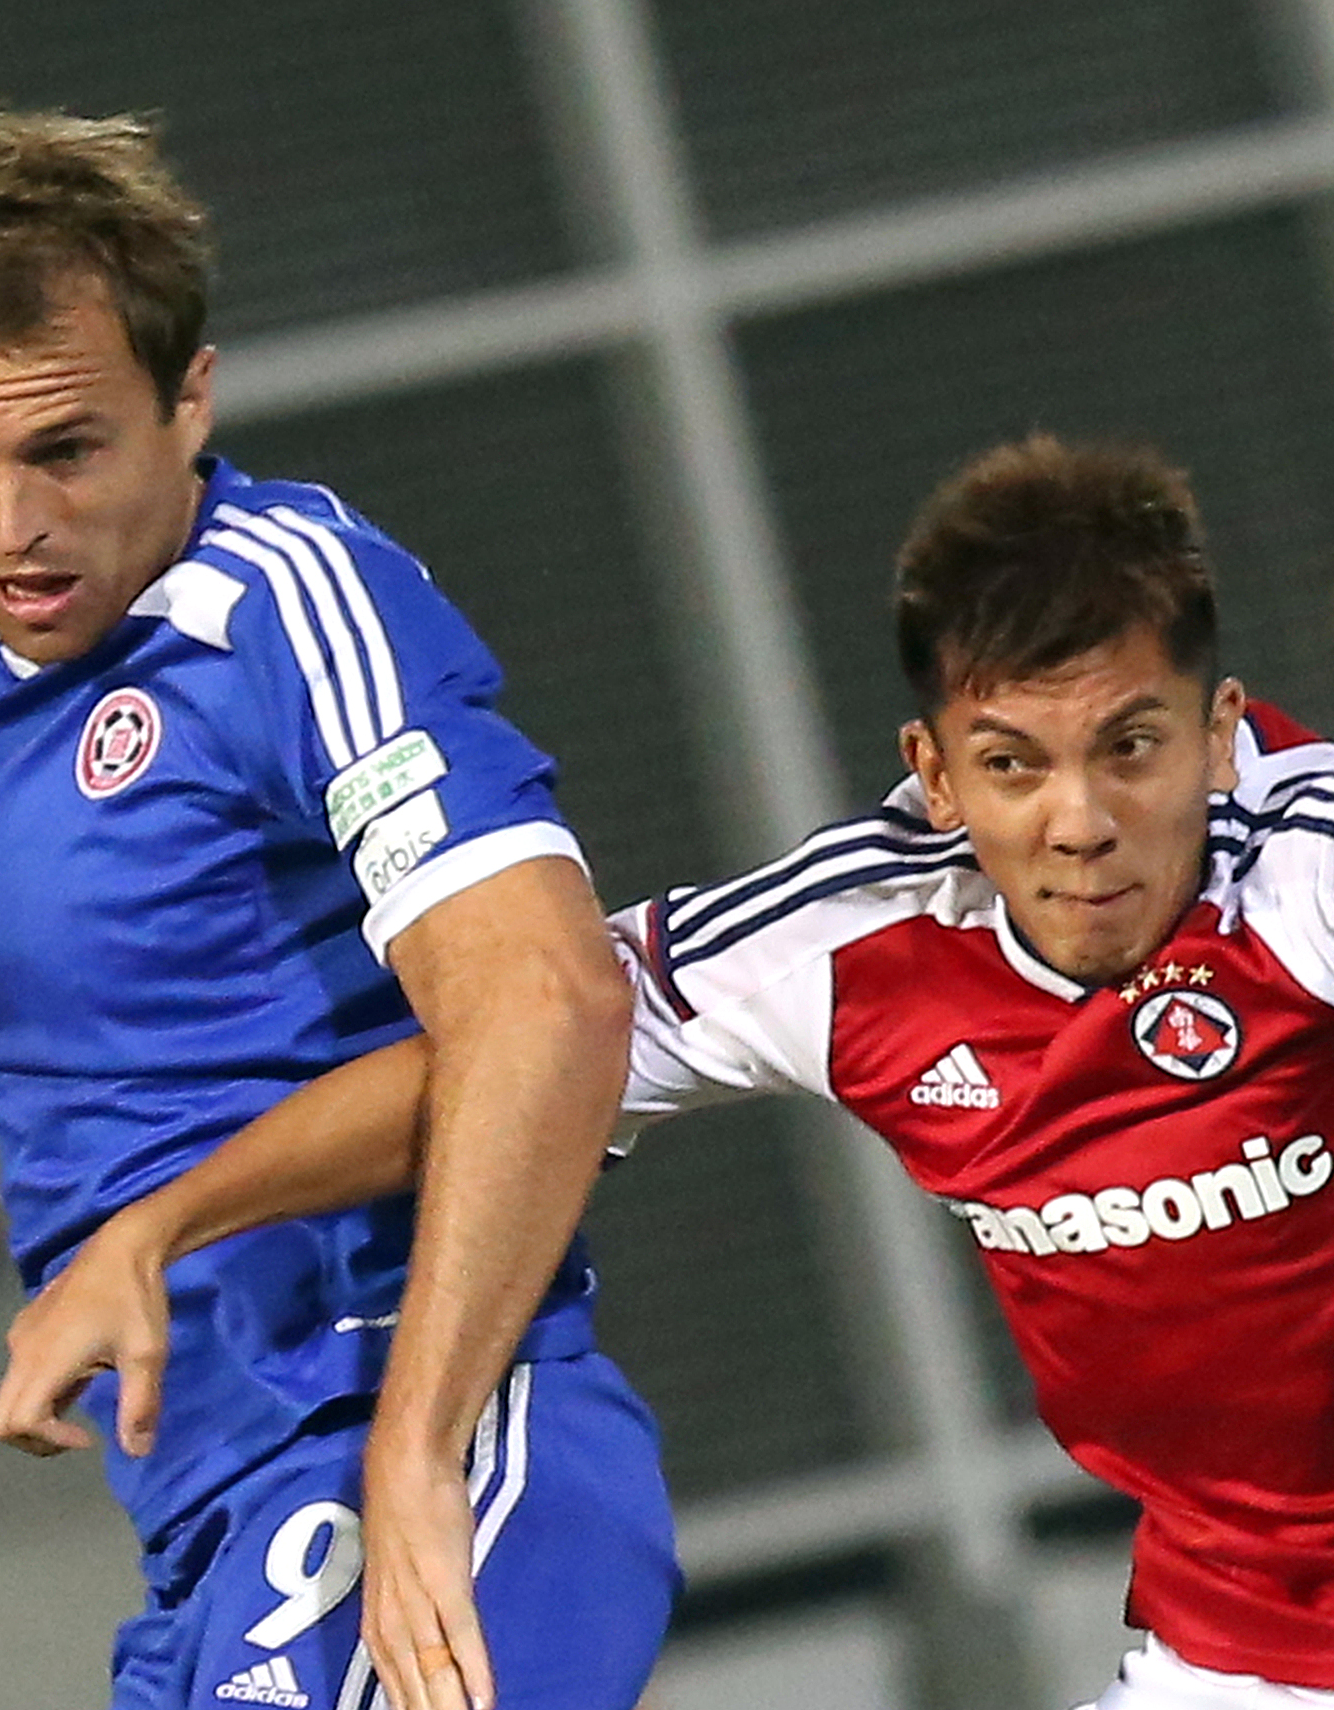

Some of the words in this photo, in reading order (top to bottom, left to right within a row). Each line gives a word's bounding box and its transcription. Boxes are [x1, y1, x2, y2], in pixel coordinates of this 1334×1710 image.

[910, 1083, 1000, 1109] adidas
[951, 1134, 1333, 1257] anasonic
[243, 1501, 364, 1650] 9
[216, 1683, 310, 1709] adidas
